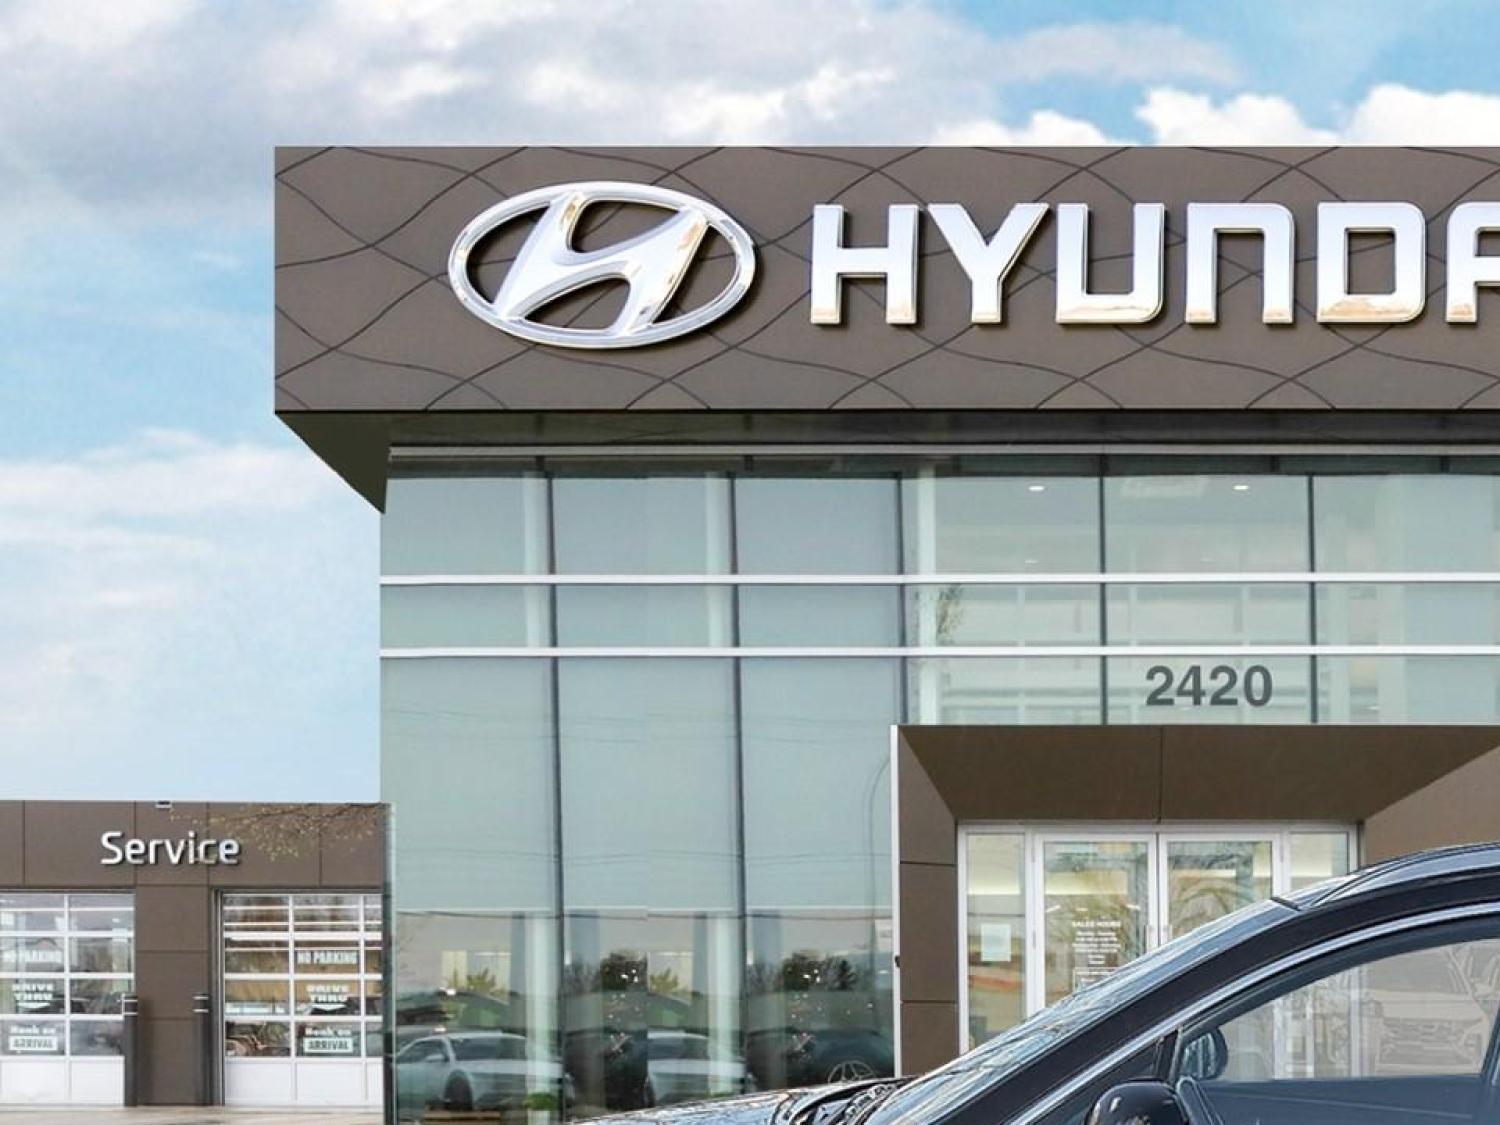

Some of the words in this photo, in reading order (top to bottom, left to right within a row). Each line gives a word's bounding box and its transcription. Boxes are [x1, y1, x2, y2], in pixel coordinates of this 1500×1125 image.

[1146, 664, 1273, 708] 2420
[100, 830, 241, 865] Service
[313, 951, 358, 965] PARKING
[13, 1038, 54, 1049] ARRIVAL
[308, 1039, 349, 1050] ARRIVAL
